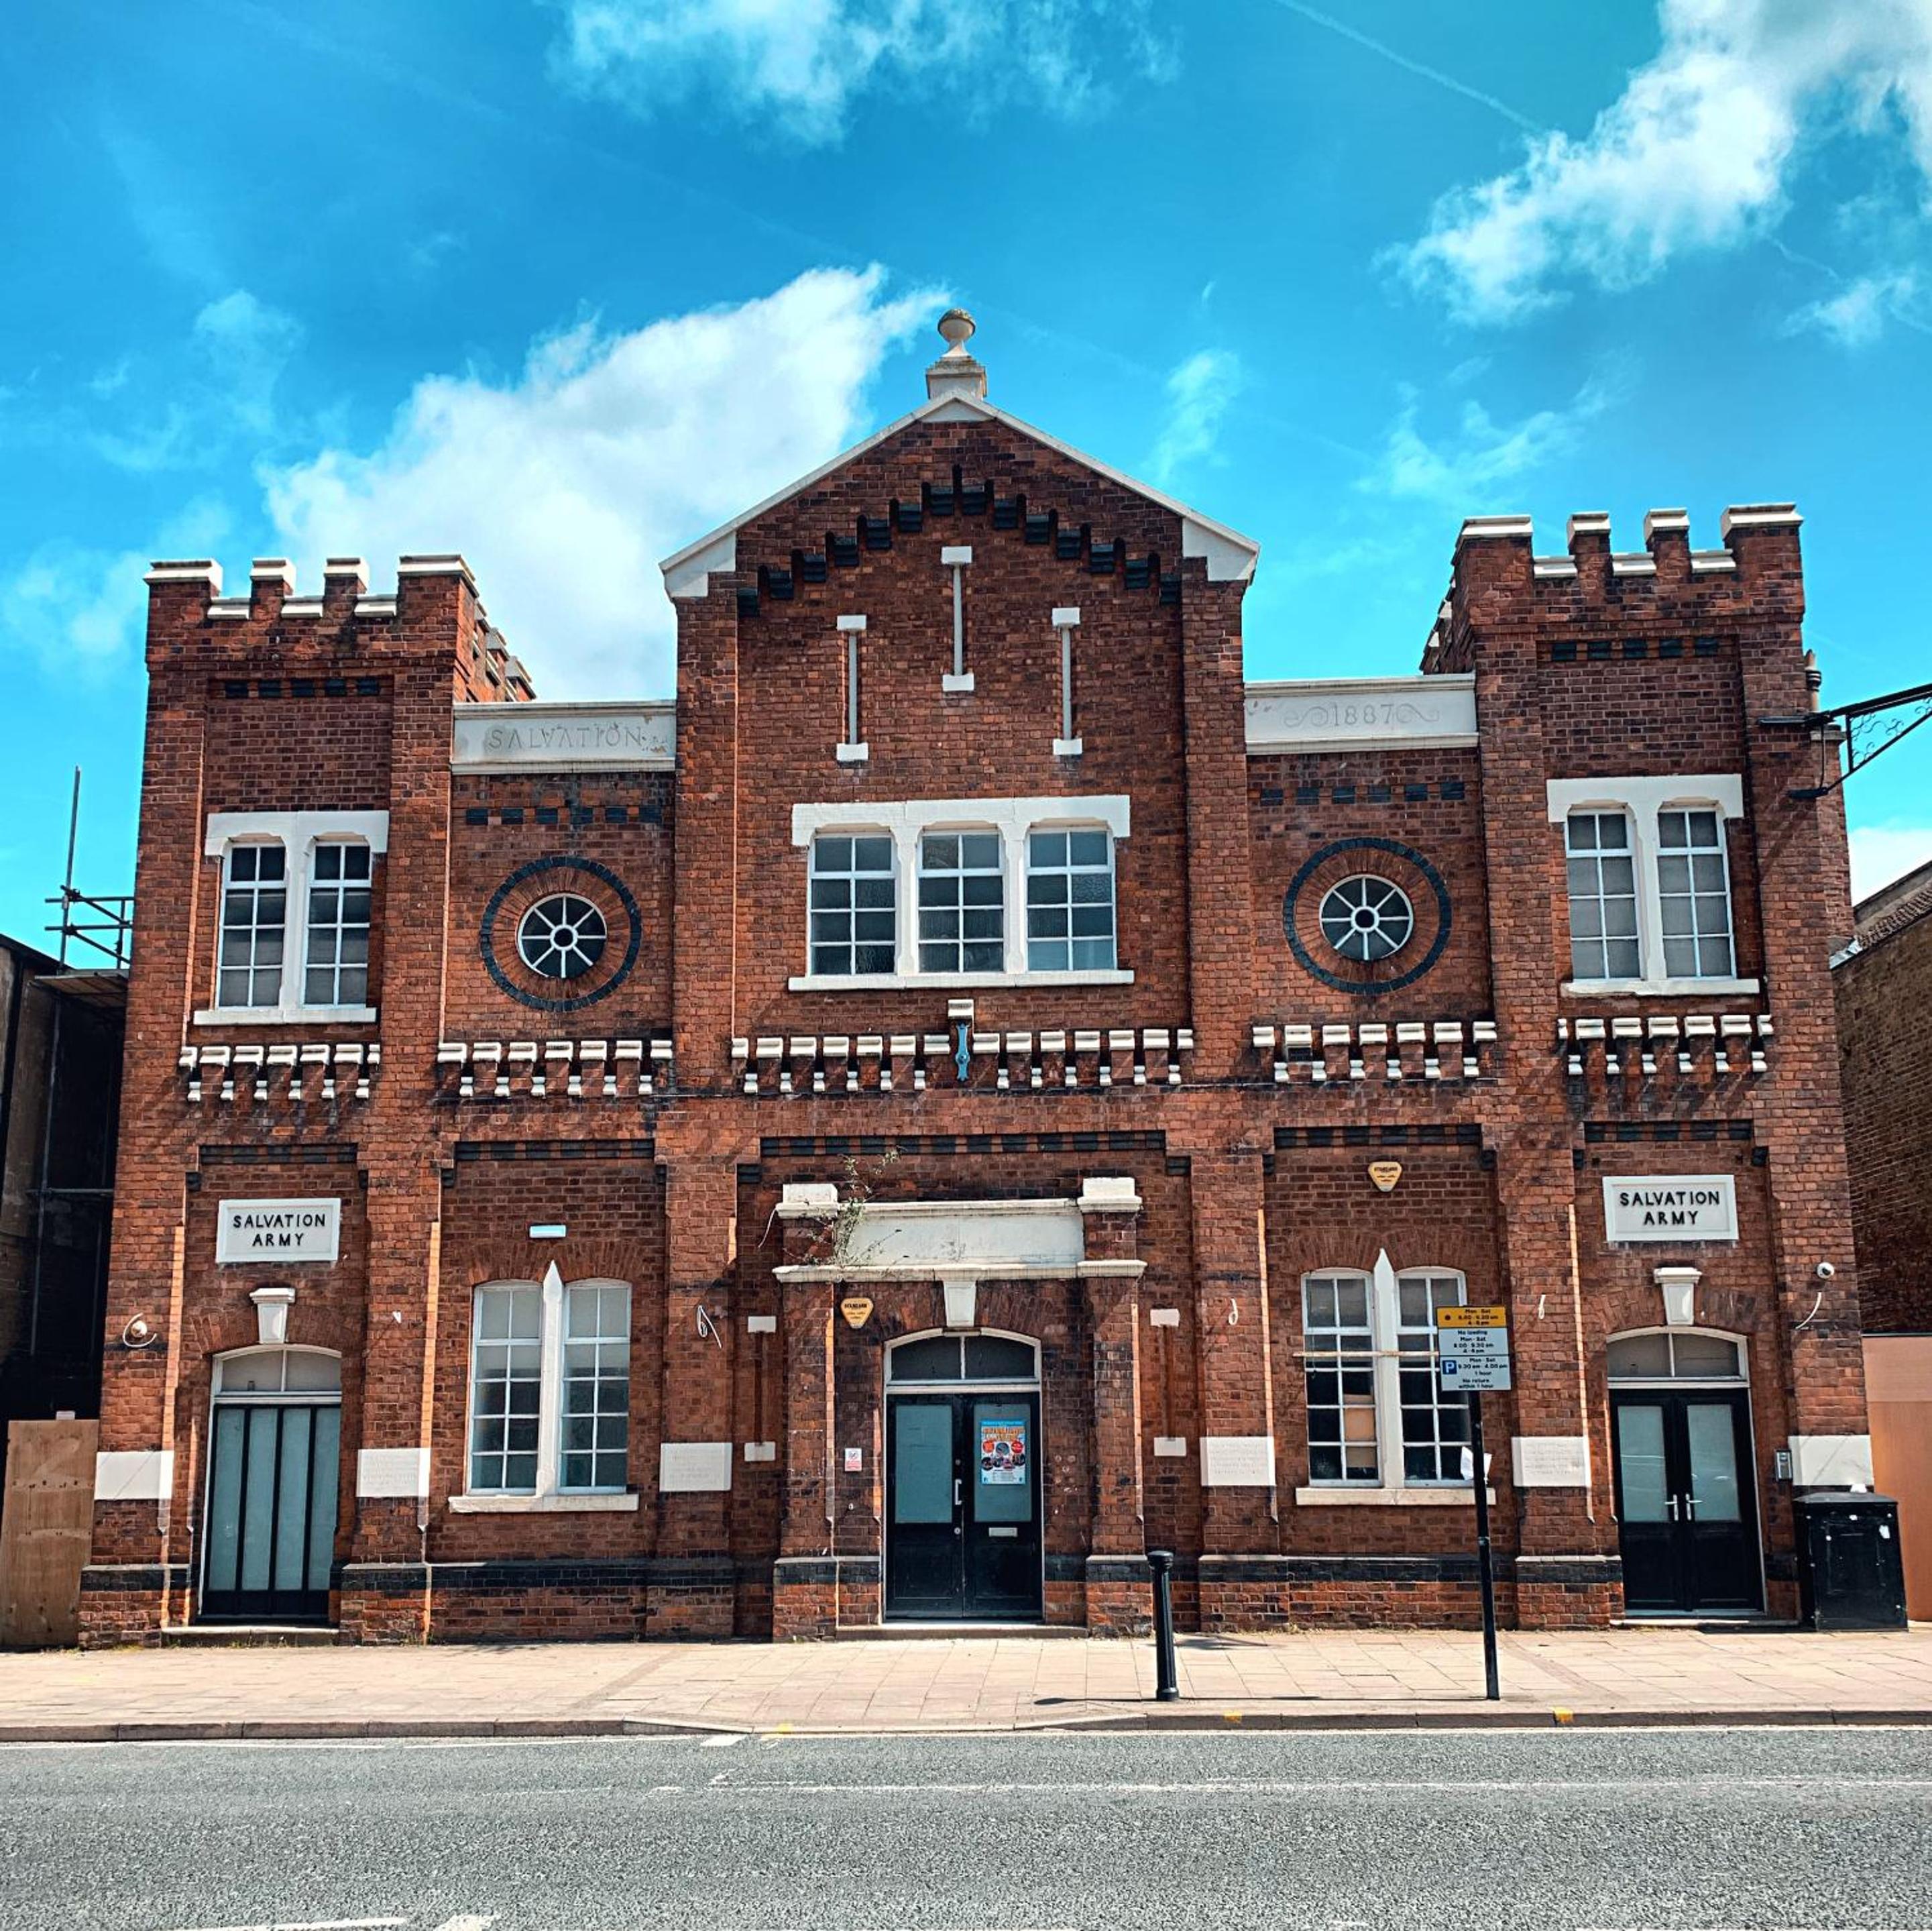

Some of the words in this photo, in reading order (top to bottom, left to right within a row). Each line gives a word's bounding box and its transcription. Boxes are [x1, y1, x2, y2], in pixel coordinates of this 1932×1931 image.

[1334, 704, 1395, 727] 1887
[489, 726, 642, 749] SALVATION
[1620, 1191, 1720, 1206] SALVATION
[233, 1213, 326, 1229] SALVATION
[1644, 1211, 1698, 1225] ARMY
[252, 1233, 304, 1247] ARMY
[1445, 1362, 1455, 1373] P
